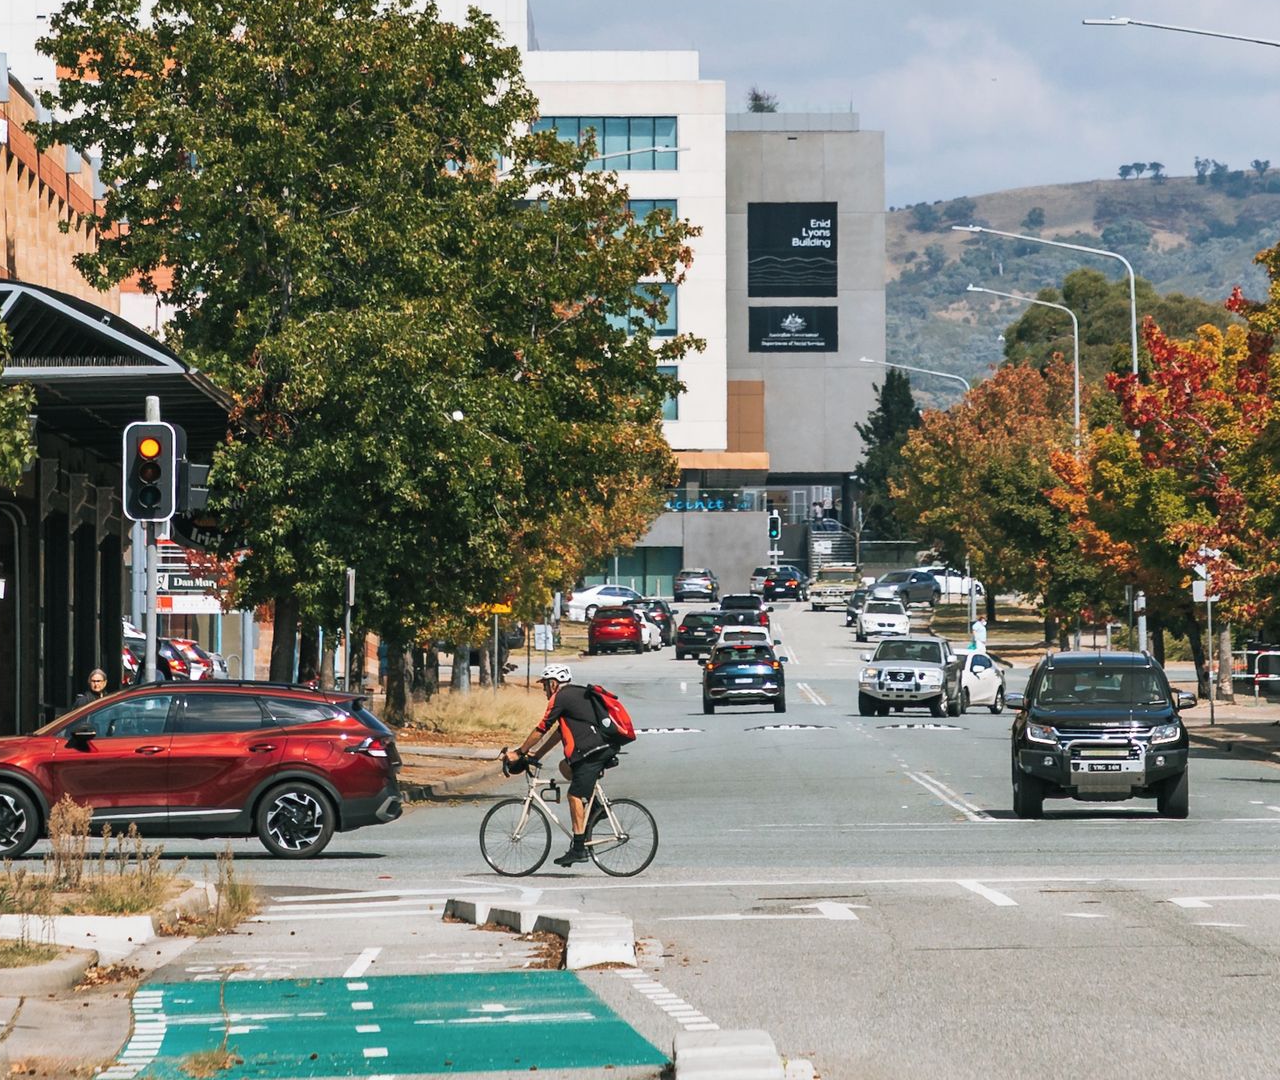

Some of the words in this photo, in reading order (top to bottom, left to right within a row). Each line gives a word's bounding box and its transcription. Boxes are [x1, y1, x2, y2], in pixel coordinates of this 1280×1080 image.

[810, 219, 831, 228] Enid
[802, 227, 831, 238] Lyons
[792, 237, 831, 248] Building
[173, 578, 194, 587] Dan
